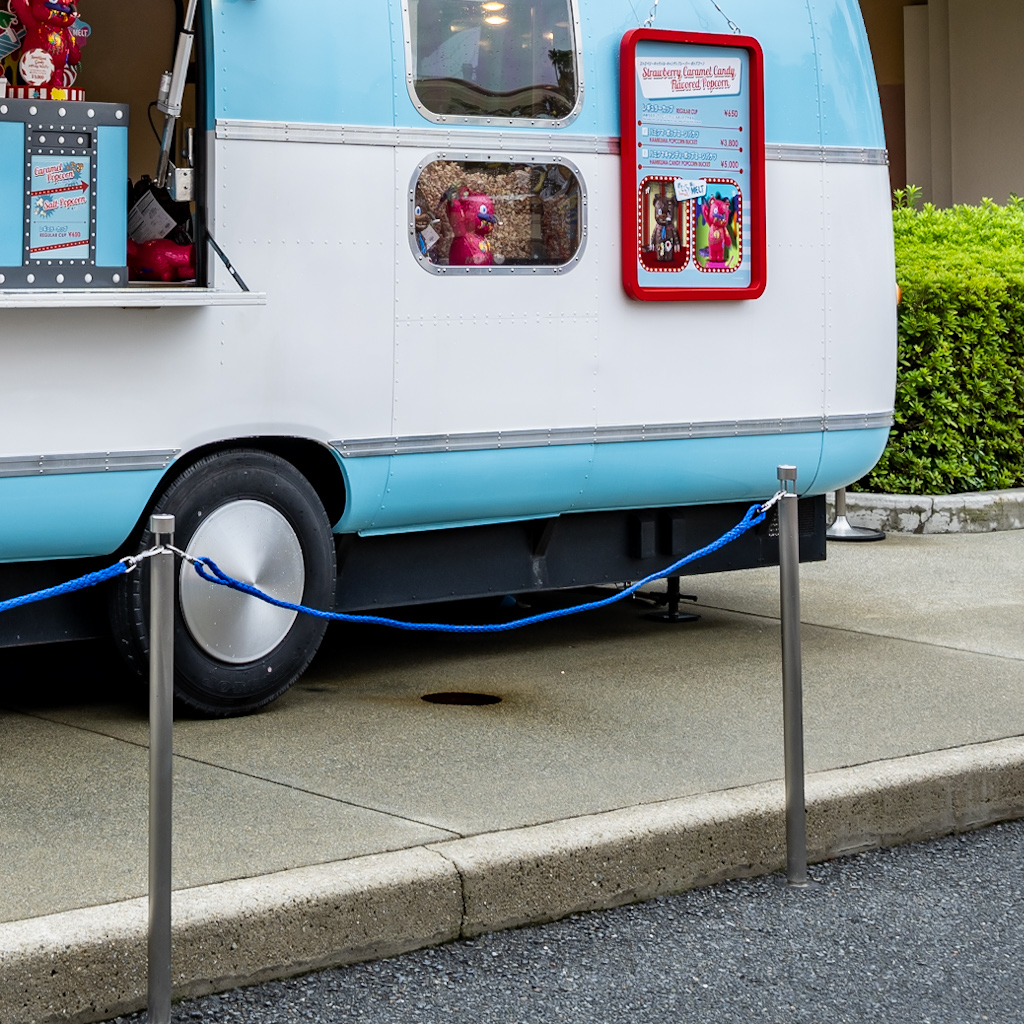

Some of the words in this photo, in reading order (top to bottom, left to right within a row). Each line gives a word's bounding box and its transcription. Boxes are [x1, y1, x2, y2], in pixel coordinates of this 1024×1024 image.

[642, 66, 681, 80] Strawberry
[683, 66, 712, 78] Caramel
[713, 65, 736, 79] Candy
[671, 79, 701, 91] Flavored
[702, 78, 730, 92] Popcorn
[47, 171, 74, 184] Popcorn
[43, 199, 58, 211] Salt
[59, 195, 87, 208] Popcorn
